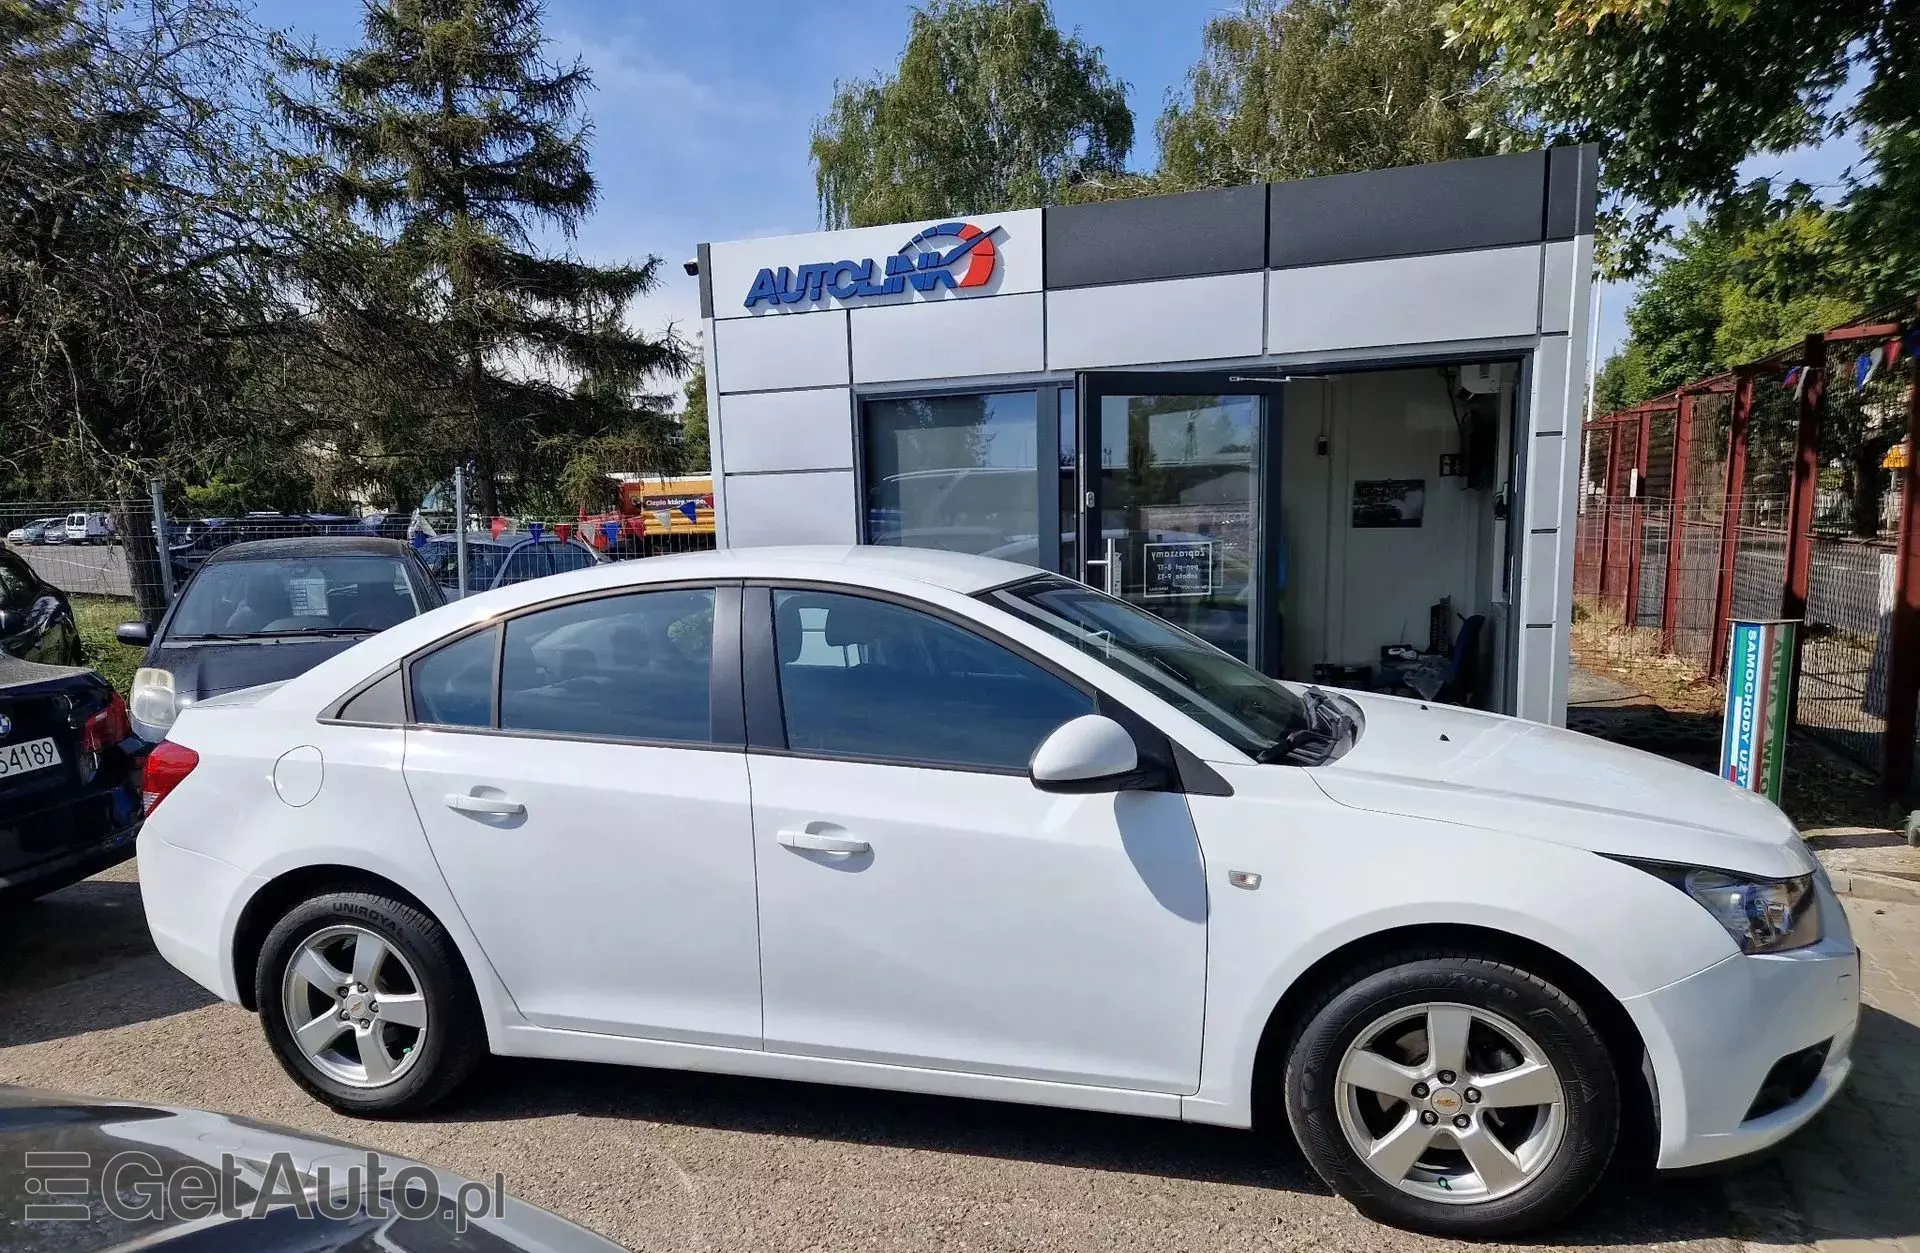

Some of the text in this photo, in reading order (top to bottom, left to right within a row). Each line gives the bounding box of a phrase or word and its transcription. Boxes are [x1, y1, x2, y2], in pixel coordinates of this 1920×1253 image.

[743, 251, 960, 308] AUTOLINK
[1740, 629, 1758, 745] SAMOCHODY
[1767, 638, 1783, 708] AUTA
[1765, 714, 1775, 730] Z
[332, 902, 404, 938] UNIROYAL
